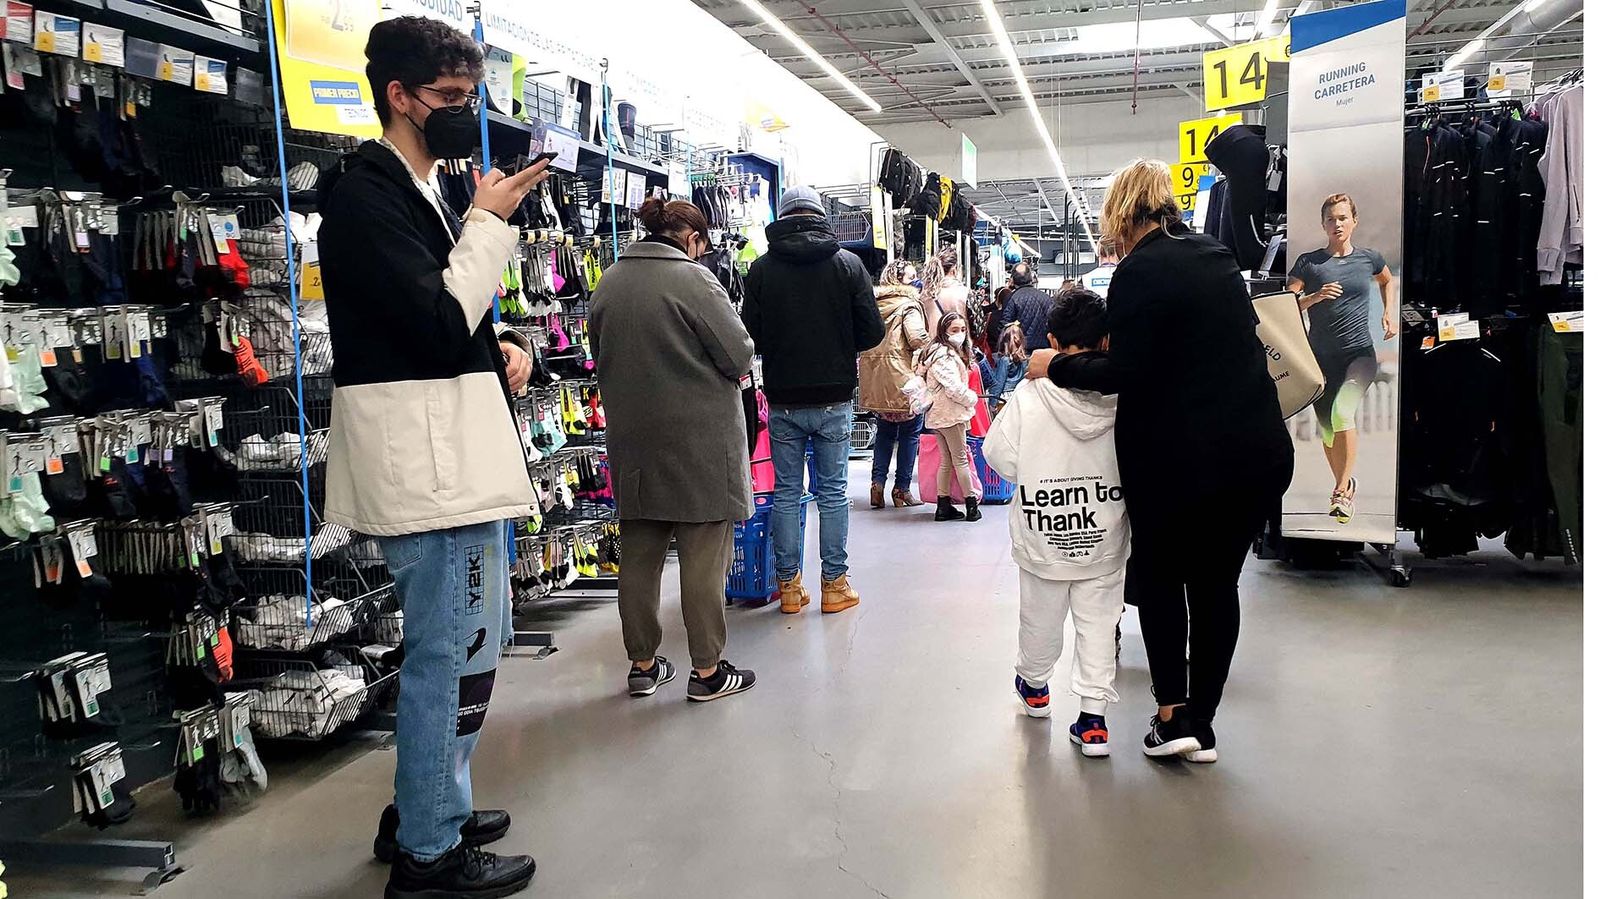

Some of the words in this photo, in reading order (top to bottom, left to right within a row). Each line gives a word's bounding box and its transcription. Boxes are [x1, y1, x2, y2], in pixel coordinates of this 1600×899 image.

[1213, 51, 1265, 98] 14
[1319, 62, 1366, 84] RUNNING
[1314, 74, 1376, 100] CARRETERA
[1336, 97, 1354, 107] Mujer
[1182, 167, 1194, 188] 9
[1181, 195, 1191, 210] 9
[1020, 484, 1089, 508] Learn
[1095, 481, 1123, 503] to
[1022, 506, 1098, 532] Thank
